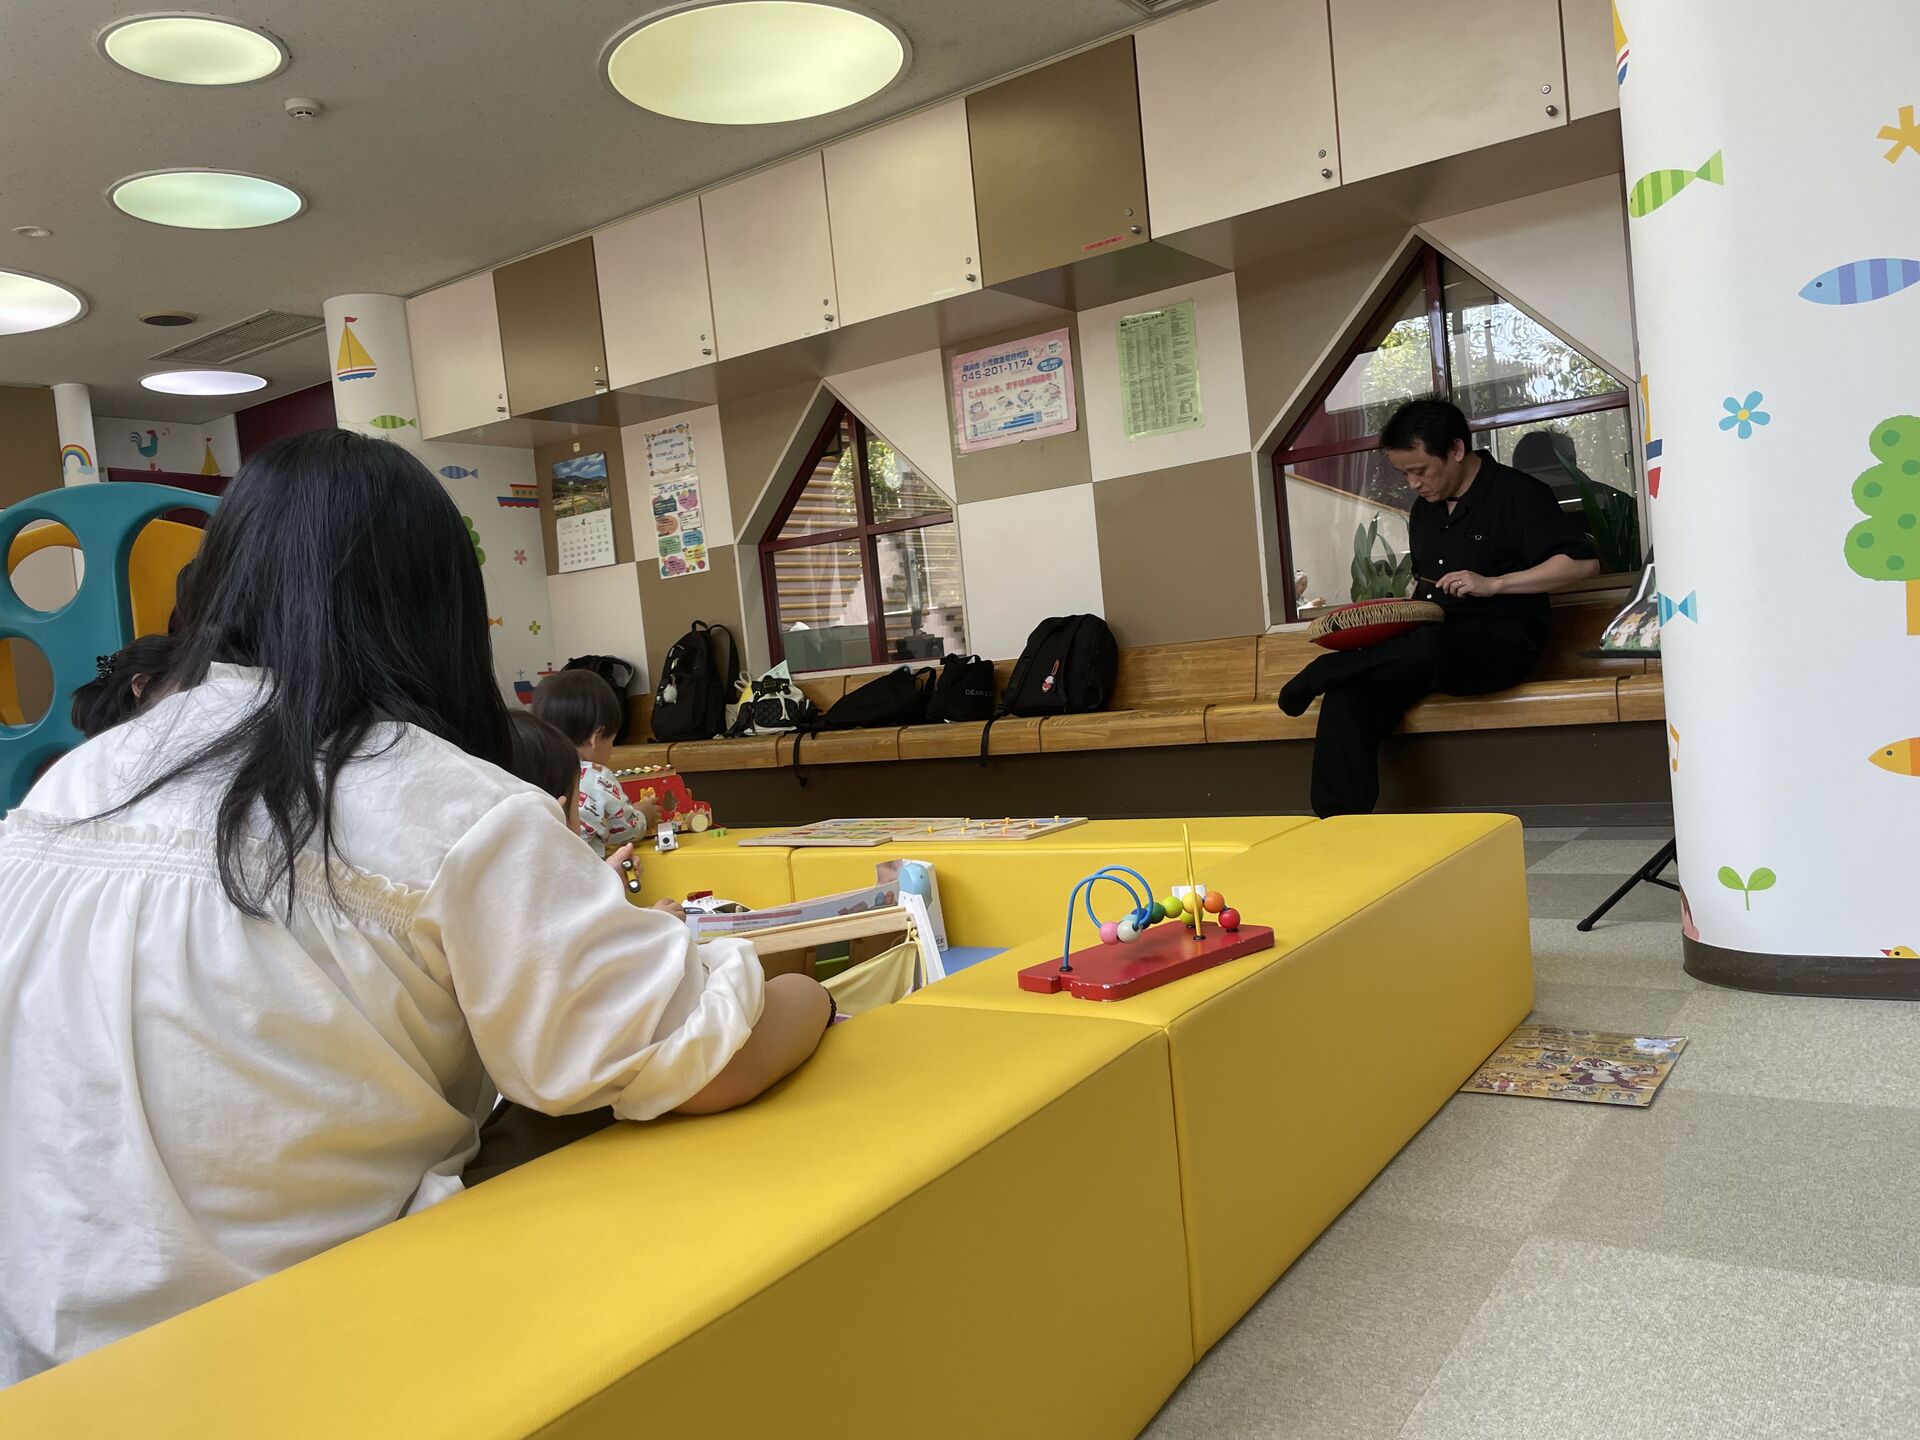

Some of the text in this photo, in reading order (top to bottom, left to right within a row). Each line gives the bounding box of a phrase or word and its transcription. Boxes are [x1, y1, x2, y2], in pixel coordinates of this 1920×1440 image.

[961, 358, 1033, 383] 045-201-1174
[581, 518, 586, 526] 4
[965, 689, 985, 697] DEAN
